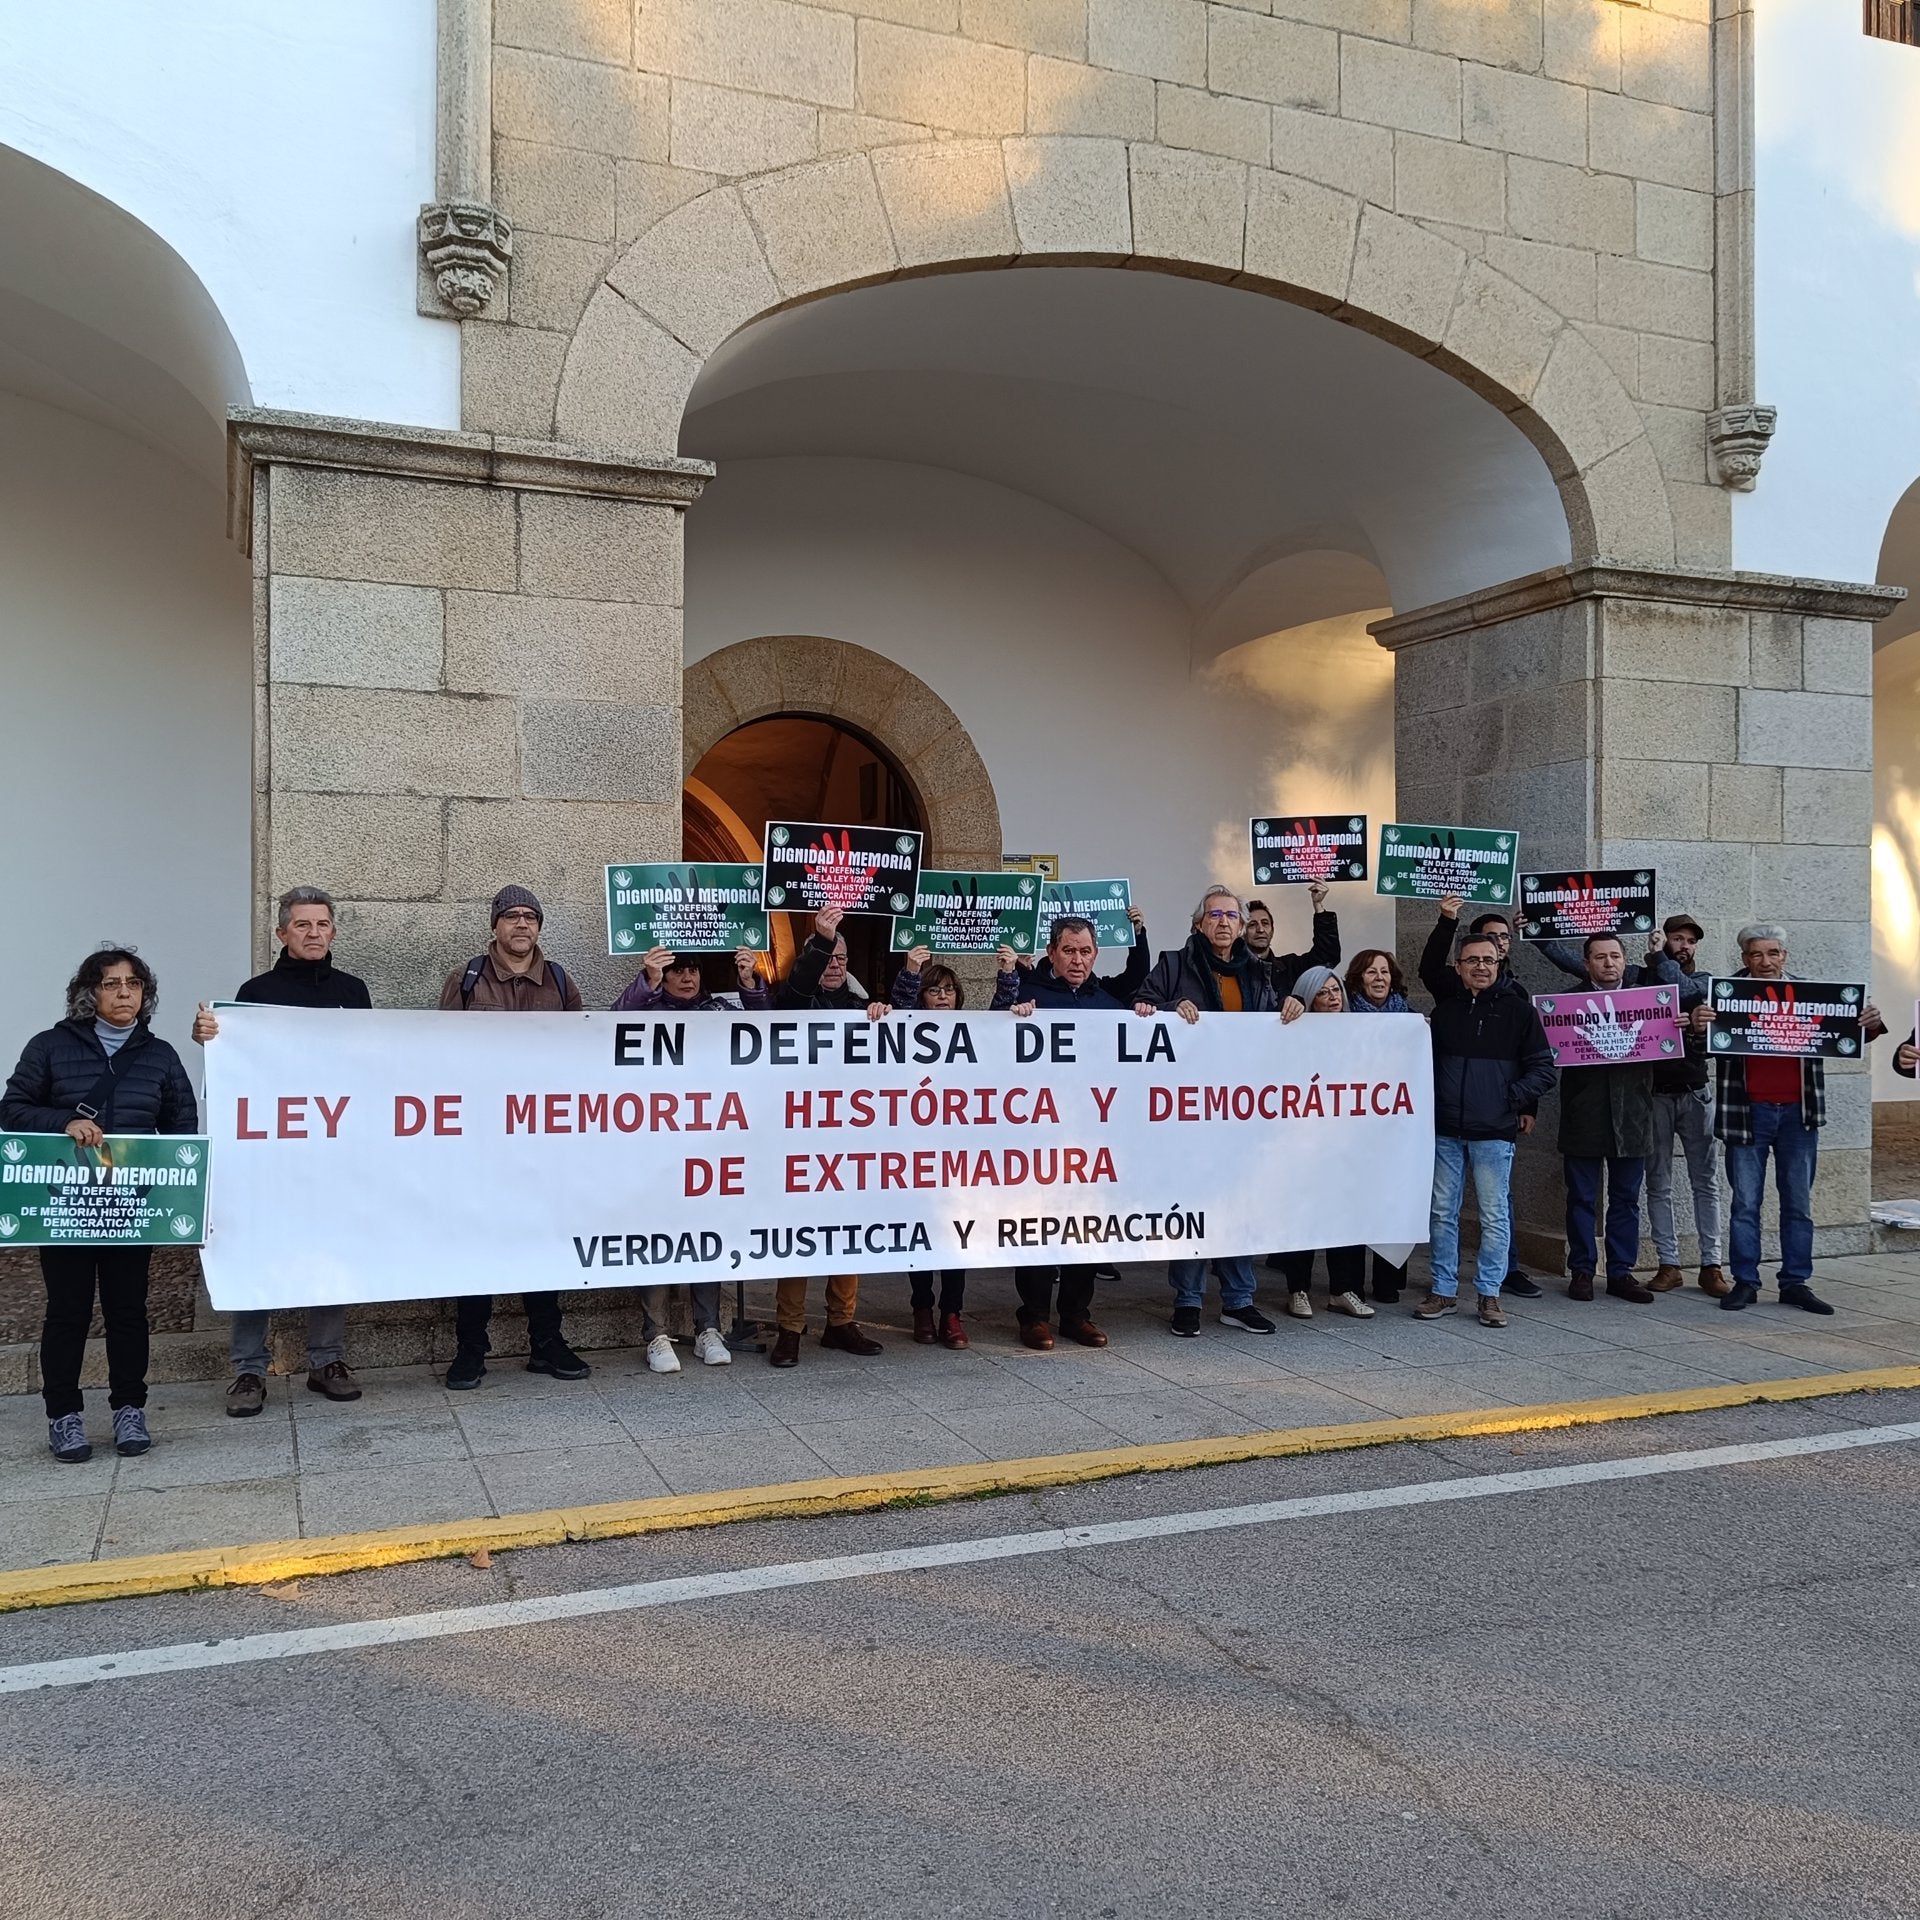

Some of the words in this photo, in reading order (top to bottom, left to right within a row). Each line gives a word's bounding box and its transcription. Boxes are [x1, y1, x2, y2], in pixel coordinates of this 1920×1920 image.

[773, 847, 835, 866] DIGNIDAD
[839, 852, 847, 867] Y
[850, 853, 911, 870] MEMORIA
[1386, 844, 1440, 860] DIGNIDAD
[1444, 849, 1451, 860] Y
[1454, 849, 1509, 864] MEMORIA
[1436, 861, 1470, 869] DEFENSA
[829, 867, 866, 875] DEFENSA
[1410, 873, 1445, 881] MEMORIA
[799, 882, 840, 891] MEMORIA
[842, 884, 885, 893] HISTÓRICA
[616, 889, 682, 905] DIGNIDAD
[685, 890, 694, 904] Y
[697, 889, 760, 904] MEMORIA
[802, 891, 863, 900] DEMOCRÁTICA
[1526, 890, 1580, 903] DIGNIDAD
[1583, 890, 1591, 901] Y
[1593, 887, 1649, 900] MEMORIA
[917, 895, 961, 909] GNIDAD
[964, 896, 972, 909] Y
[975, 896, 1032, 910] MEMORIA
[1063, 901, 1071, 913] Y
[1074, 899, 1125, 912] MEMORIA
[1576, 900, 1610, 908] DEFENSA
[692, 921, 736, 929] HISTÓRICA
[968, 925, 1008, 933] HISTÓRICA
[652, 929, 717, 937] DEMOCRÁTICA
[931, 933, 988, 941] DEMOCRÁTICA
[1717, 999, 1778, 1014] DIGNIDAD
[1782, 1002, 1790, 1014] Y
[1794, 1002, 1857, 1017] MEMORIA
[1543, 1012, 1600, 1027] DIGNIDAD
[1603, 1011, 1612, 1023] Y
[1614, 1007, 1672, 1022] MEMORIA
[1596, 1023, 1633, 1031] DEFENSA
[615, 1023, 685, 1065] EN
[731, 1022, 971, 1065] DEFENSA
[1016, 1022, 1076, 1064] DE
[1118, 1022, 1176, 1063] LA
[1571, 1038, 1609, 1046] MEMORIA
[1753, 1044, 1817, 1053] EXTREMADURA
[1580, 1051, 1641, 1060] EXTREMADURA
[237, 1096, 350, 1140] LEY
[395, 1095, 462, 1137] DE
[507, 1092, 749, 1135] MEMORIA
[785, 1077, 1059, 1129] HISTÓRICA
[1091, 1086, 1117, 1122] Y
[1150, 1073, 1414, 1121] DEMOCRÁTICA
[3, 1165, 89, 1184] DIGNIDAD
[95, 1167, 107, 1185] Y
[112, 1167, 197, 1185] MEMORIA
[685, 1156, 744, 1196] DE
[786, 1147, 1117, 1193] EXTREMADURA
[63, 1186, 78, 1195] EN
[82, 1187, 136, 1195] DEFENSA
[50, 1198, 67, 1206] DE
[70, 1198, 86, 1206] LA
[89, 1198, 110, 1206] LEY
[115, 1198, 146, 1206] 1/2019
[21, 1207, 37, 1216] DE
[40, 1208, 98, 1216] MEMORIA
[101, 1206, 162, 1217] HISTÓRICA
[166, 1208, 173, 1217] Y
[43, 1217, 131, 1227] DEMOCRÁTICA
[135, 1219, 149, 1227] DE
[953, 1219, 976, 1250] Y
[999, 1203, 1204, 1248] REPARACIÓN
[50, 1229, 141, 1238] EXTREMADURA
